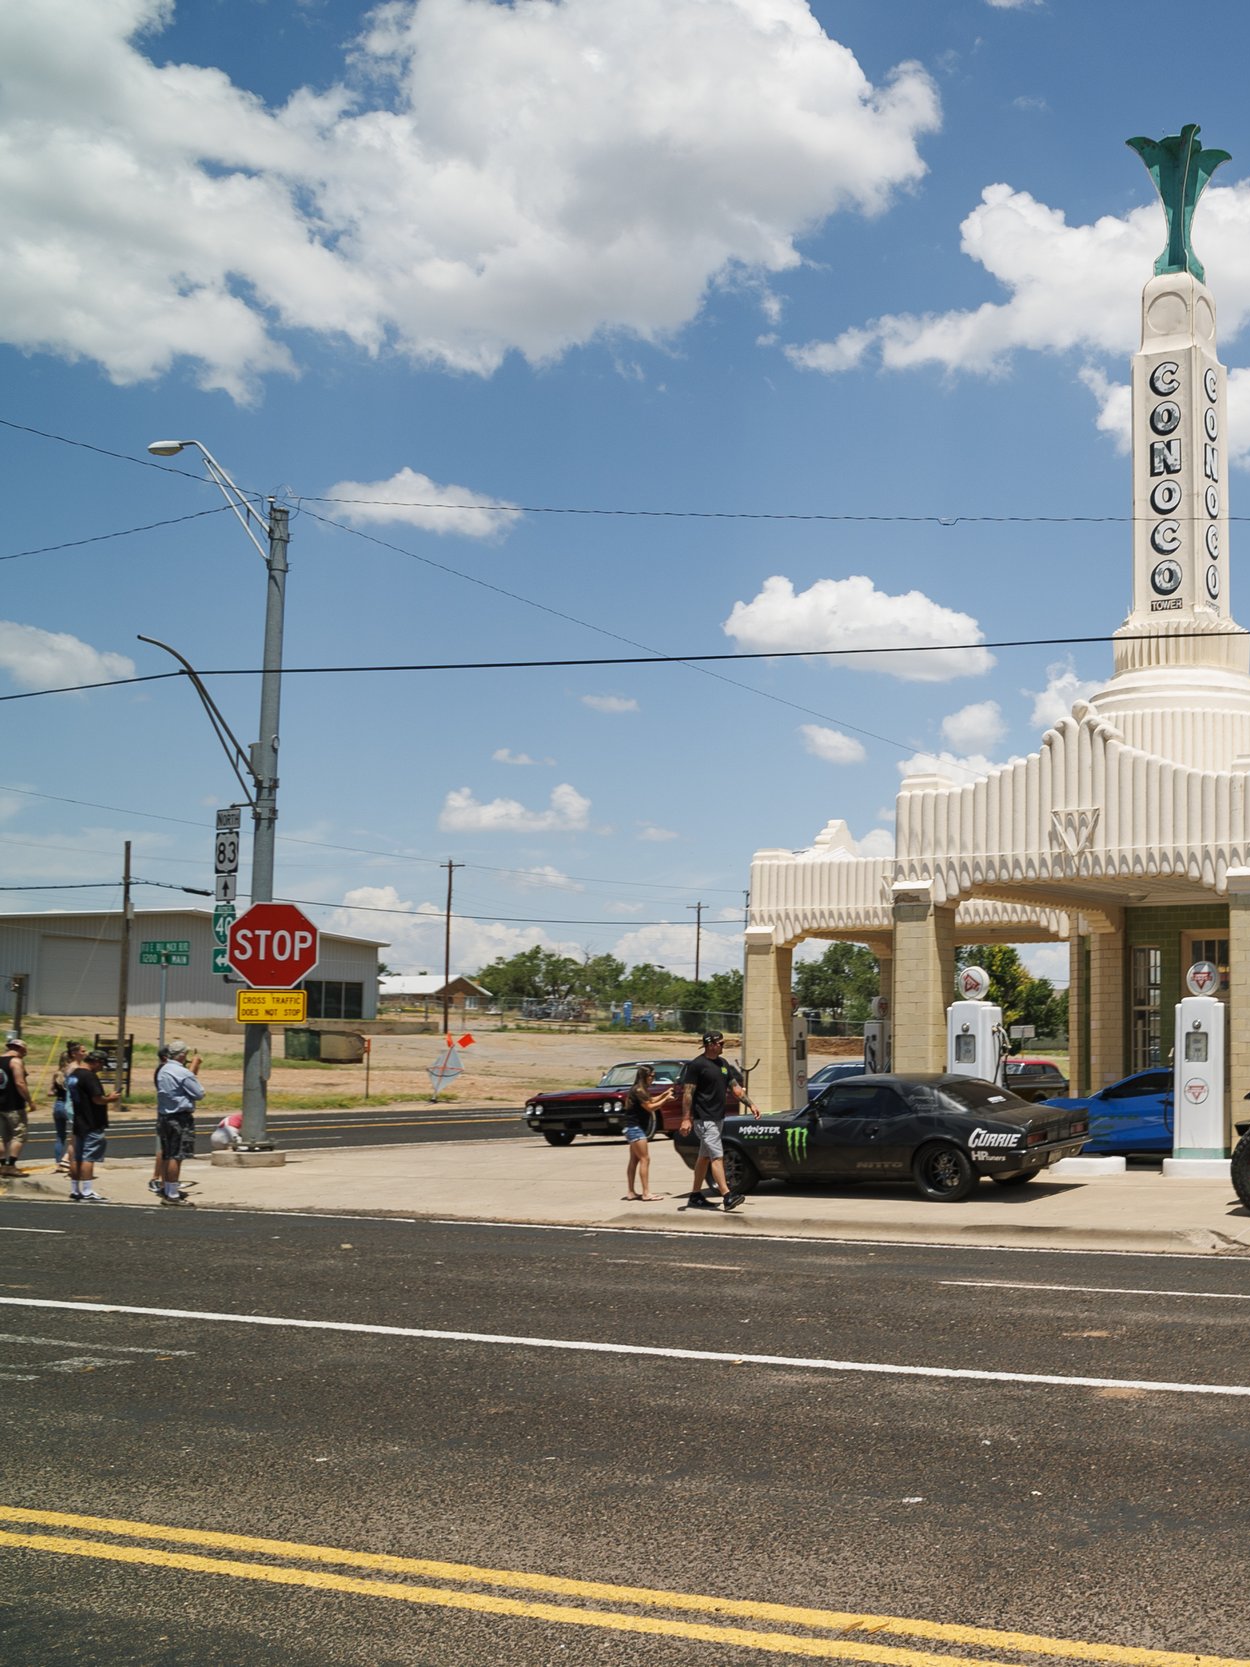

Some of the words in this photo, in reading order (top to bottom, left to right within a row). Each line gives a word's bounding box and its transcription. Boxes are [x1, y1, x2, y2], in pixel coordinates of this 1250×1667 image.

[1149, 361, 1182, 596] CONOCO
[1204, 368, 1219, 600] CONOCO
[1151, 599, 1182, 611] TOWER
[217, 842, 236, 864] 83
[234, 929, 312, 961] STOP
[242, 997, 266, 1005] CROSS
[272, 997, 301, 1005] TRAFFIC
[242, 1008, 259, 1017] DOES
[265, 1008, 278, 1017] NOT
[284, 1008, 301, 1017] STOP
[738, 1125, 781, 1135] MONSTER
[968, 1127, 1022, 1148] CURRIE
